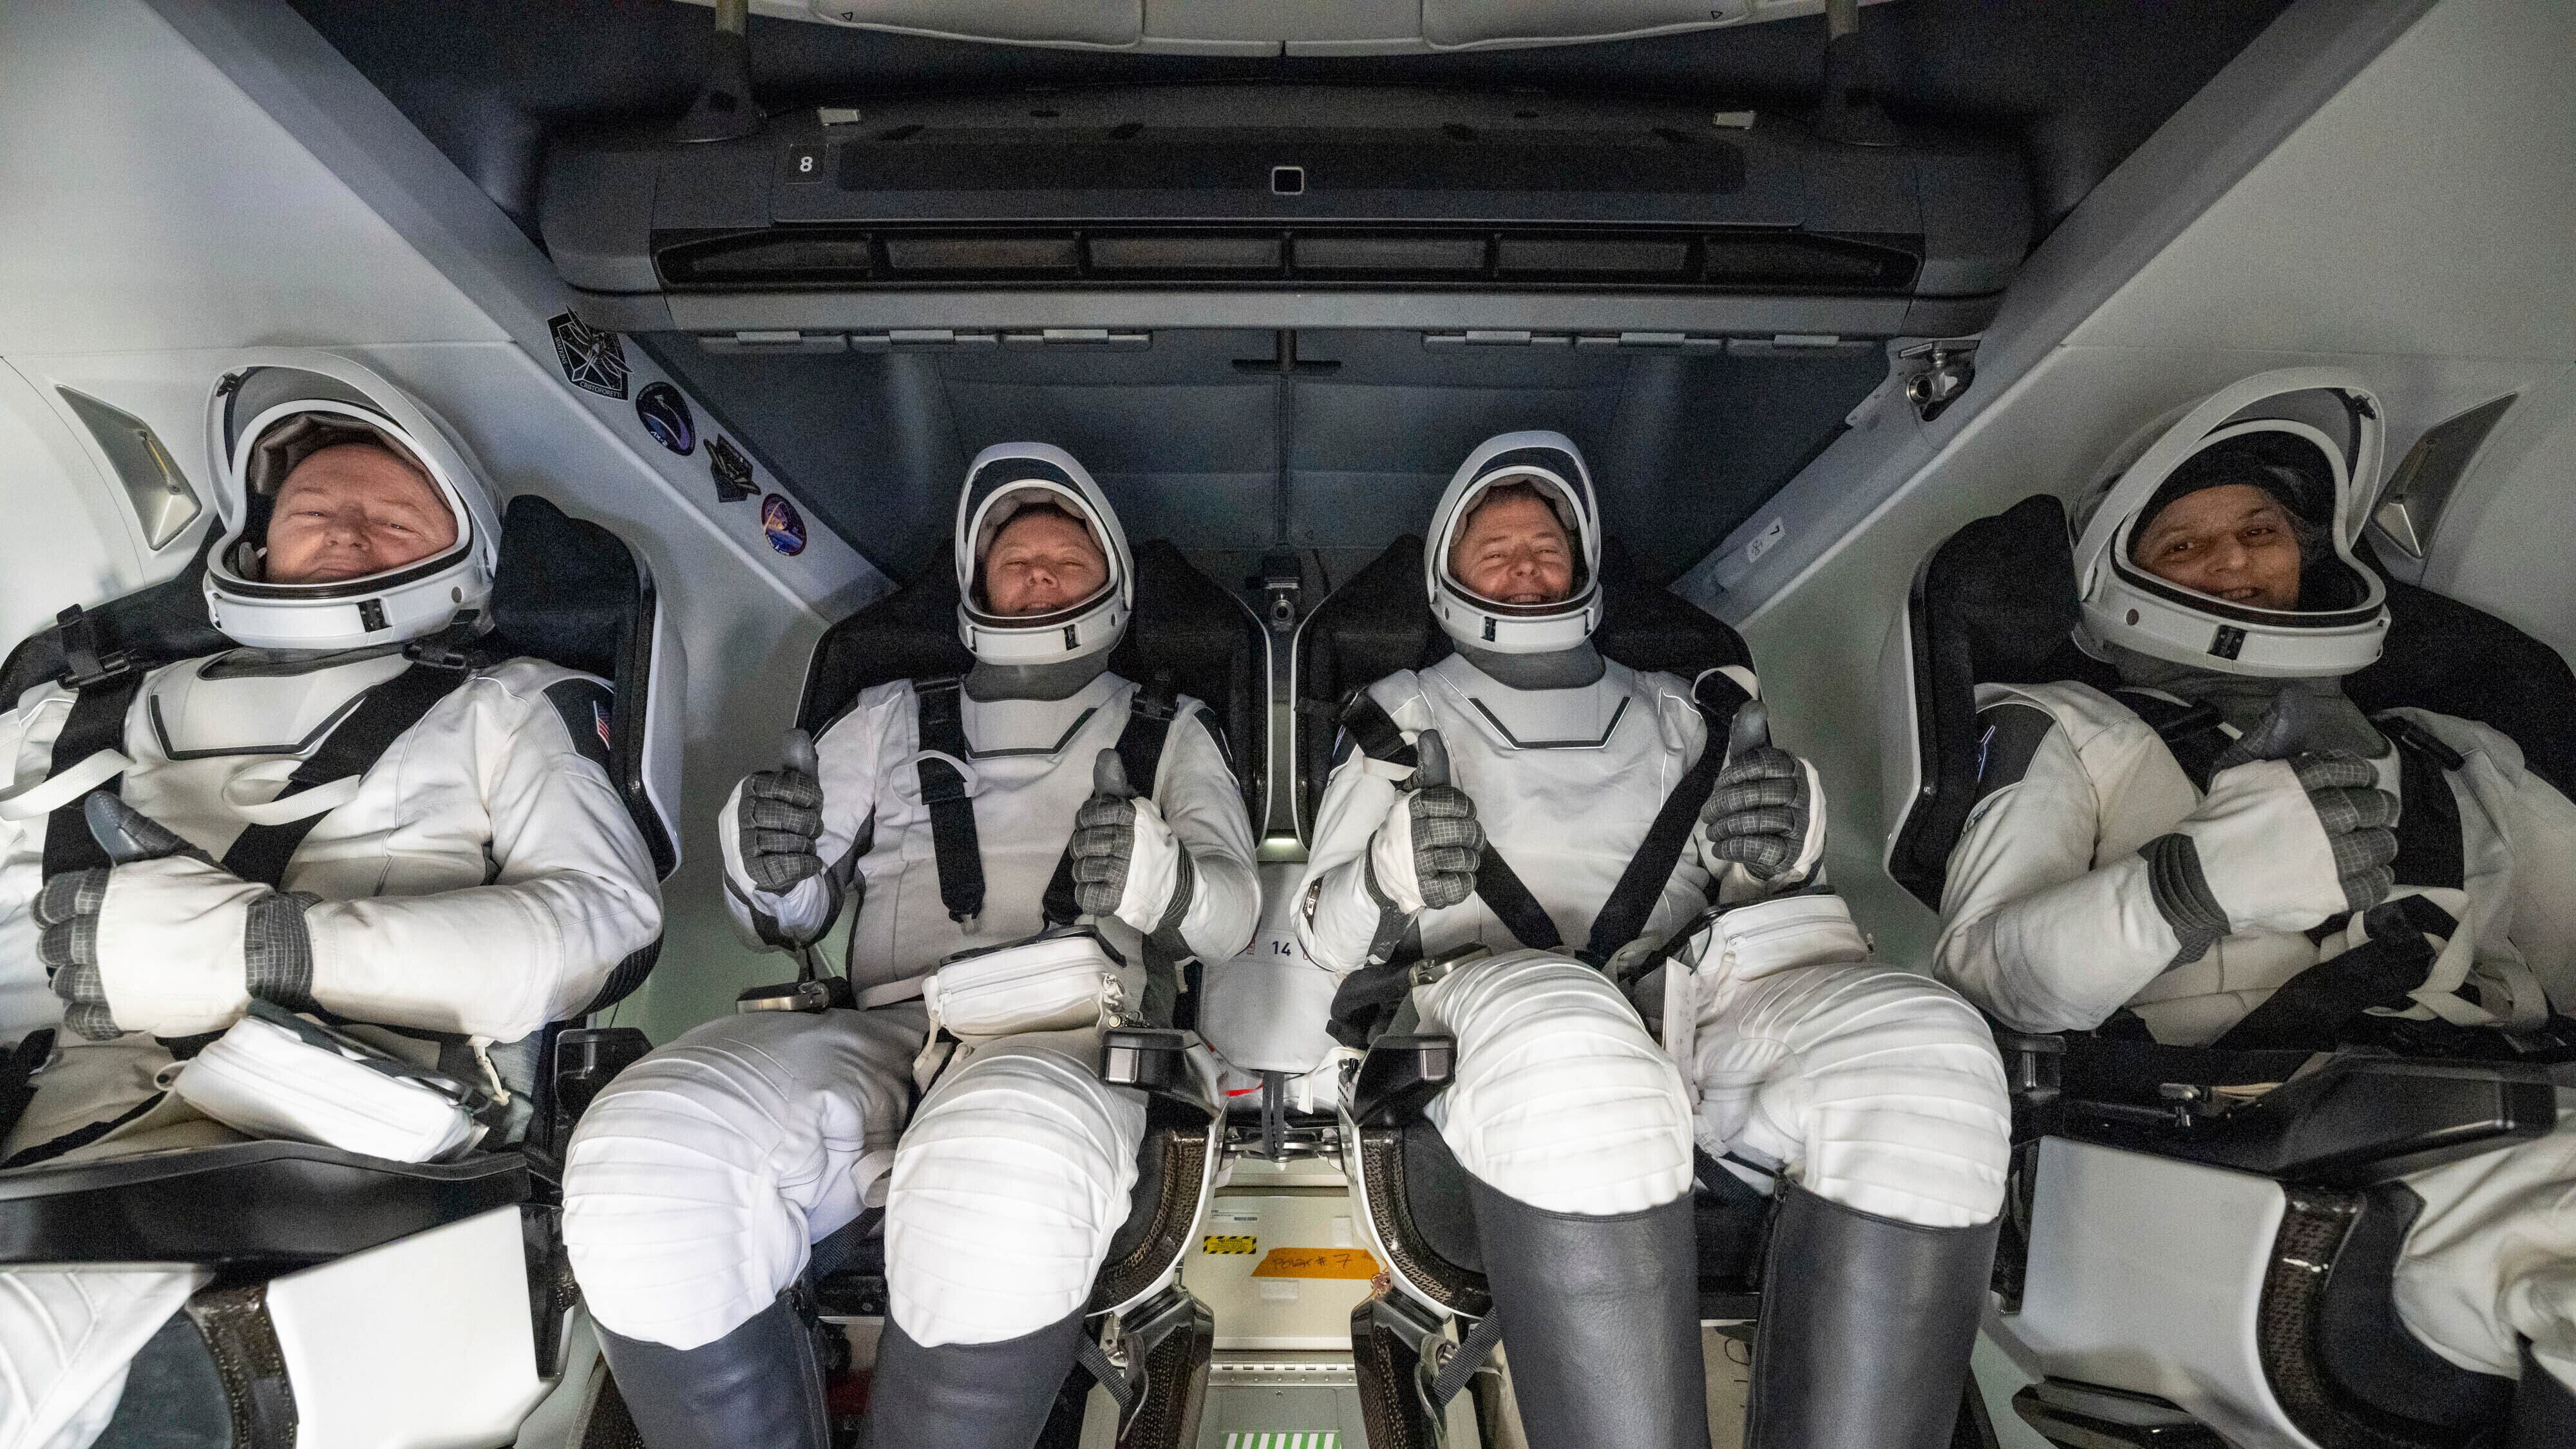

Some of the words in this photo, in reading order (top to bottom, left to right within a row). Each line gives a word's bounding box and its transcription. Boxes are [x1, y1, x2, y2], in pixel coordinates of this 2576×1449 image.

[800, 156, 813, 172] 8
[555, 337, 568, 364] WATKINS
[580, 381, 622, 398] CRISTOFORETTI
[1272, 941, 1291, 956] 14
[1316, 1256, 1327, 1267] #
[1333, 1253, 1352, 1269] 7
